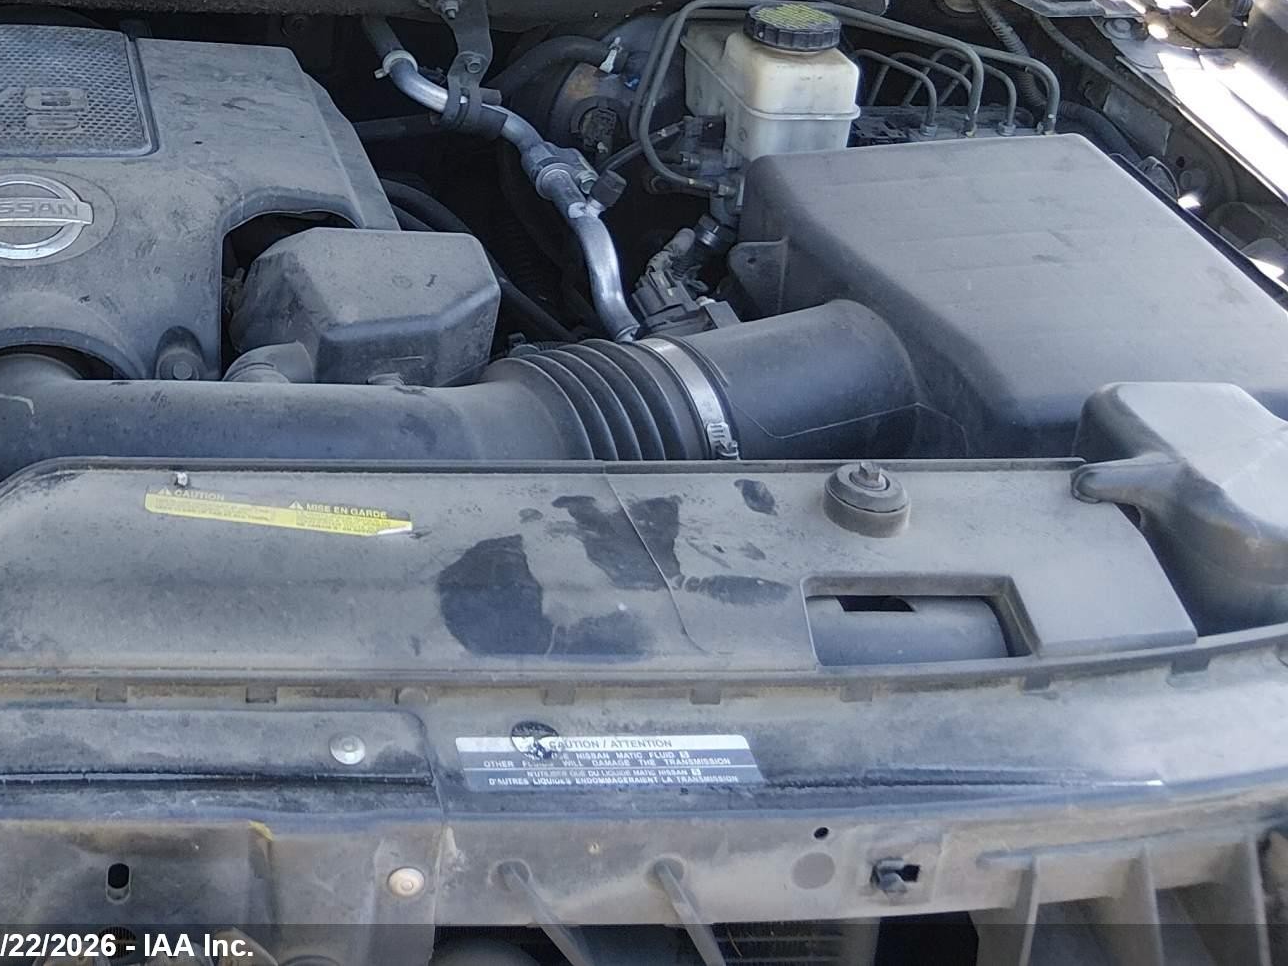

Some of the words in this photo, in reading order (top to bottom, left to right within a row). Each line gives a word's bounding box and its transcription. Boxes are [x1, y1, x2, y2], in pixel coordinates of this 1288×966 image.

[174, 488, 225, 501] CAUTION
[306, 503, 331, 513] MISE
[333, 505, 349, 515] EN
[350, 507, 388, 519] GARDE
[549, 739, 599, 750] CAUTION
[611, 738, 673, 749] ATTENTION
[575, 751, 610, 759] NISSAN
[615, 751, 643, 759] MATIC
[648, 751, 676, 759] FLUID
[483, 759, 514, 769] OTHER
[562, 759, 584, 767] WILL
[591, 758, 631, 767] DAMAGE
[638, 758, 657, 766] THE
[663, 757, 731, 766] TRANSMISSION
[488, 777, 530, 786] D'AUTRES
[661, 776, 673, 784] LA
[676, 775, 739, 784] TRANSMISSION
